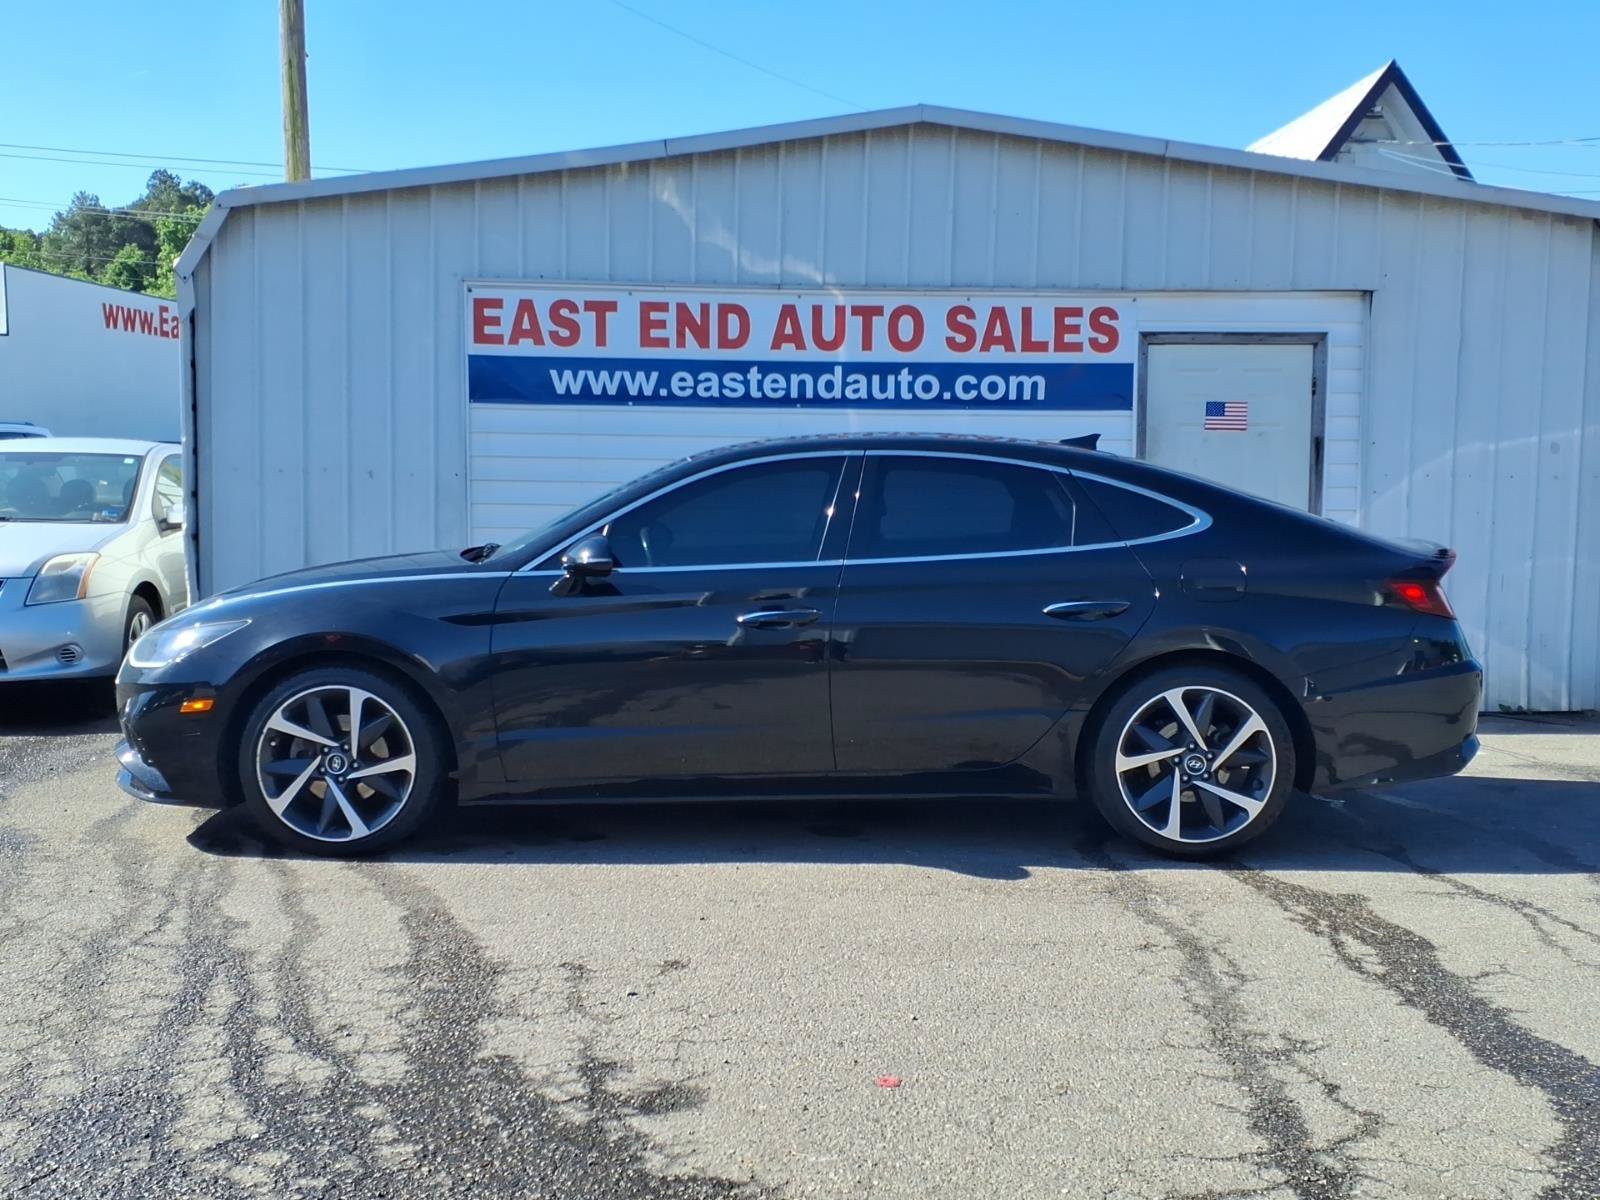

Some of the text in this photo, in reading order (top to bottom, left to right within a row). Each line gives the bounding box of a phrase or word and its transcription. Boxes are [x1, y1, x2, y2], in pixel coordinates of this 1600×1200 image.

[473, 299, 1119, 355] EAST END AUTO SALES
[549, 366, 1047, 401] www.eastendauto.com
